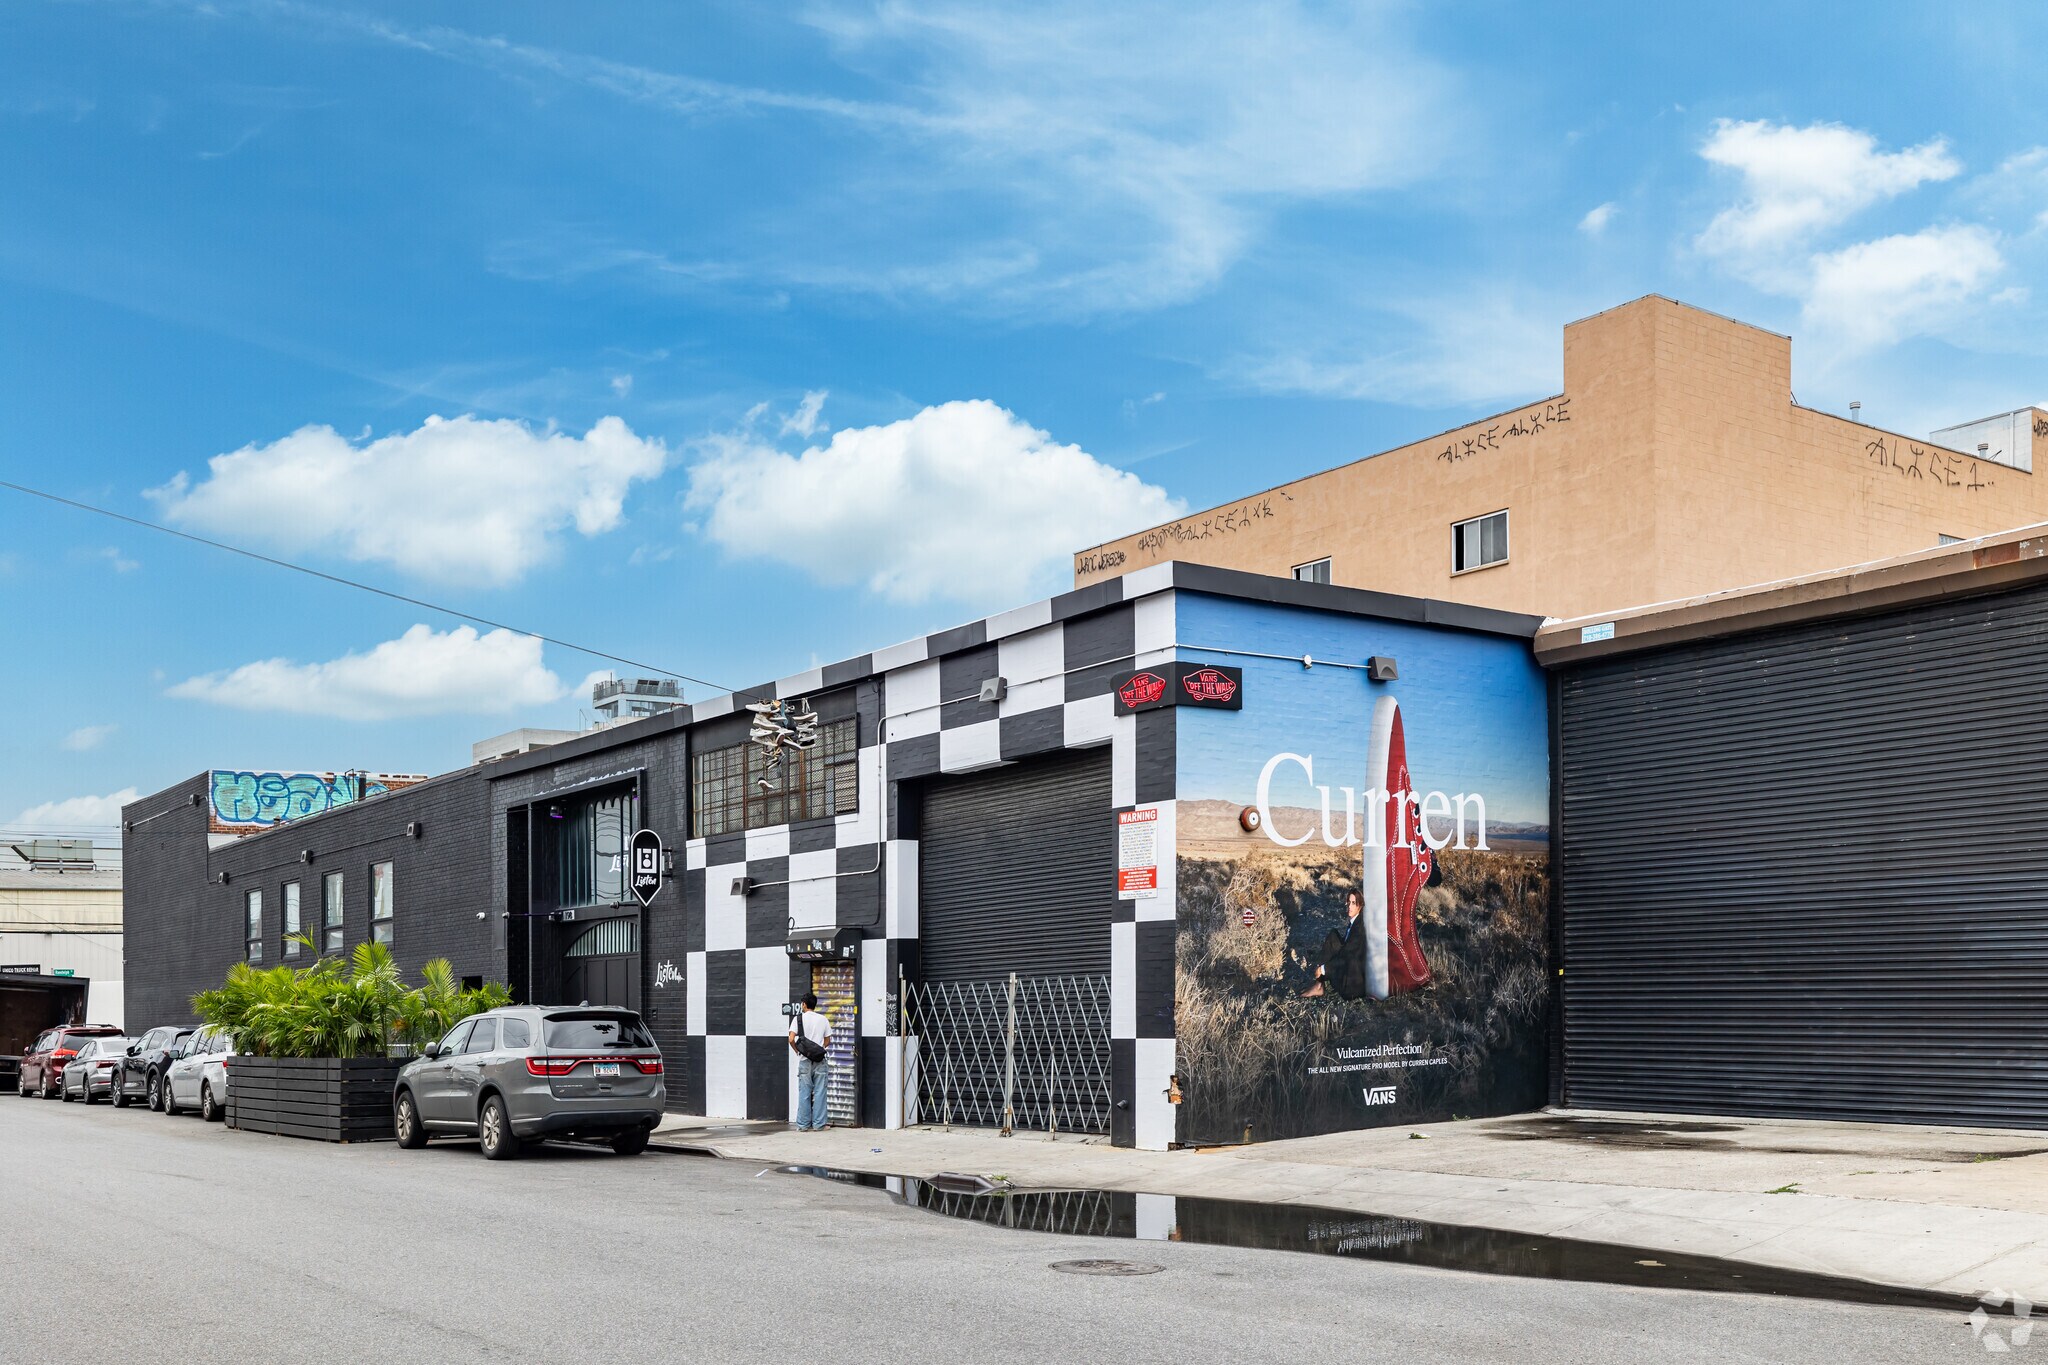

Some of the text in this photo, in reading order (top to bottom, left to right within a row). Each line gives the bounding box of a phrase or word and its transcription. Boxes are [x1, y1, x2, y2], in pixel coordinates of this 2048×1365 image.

[1199, 672, 1218, 683] VANS
[1202, 682, 1215, 694] THE
[1256, 752, 1490, 850] Curren
[1120, 810, 1156, 823] WARNING
[635, 875, 657, 887] Listen
[1336, 1044, 1422, 1059] Vulcanized Perfection
[1342, 1063, 1371, 1072] SIGNATURE
[1371, 1062, 1383, 1070] PRO
[1383, 1061, 1401, 1069] MODEL
[1408, 1059, 1429, 1067] CURREN
[1429, 1057, 1448, 1066] CAPLES
[1362, 1085, 1397, 1106] VANS
